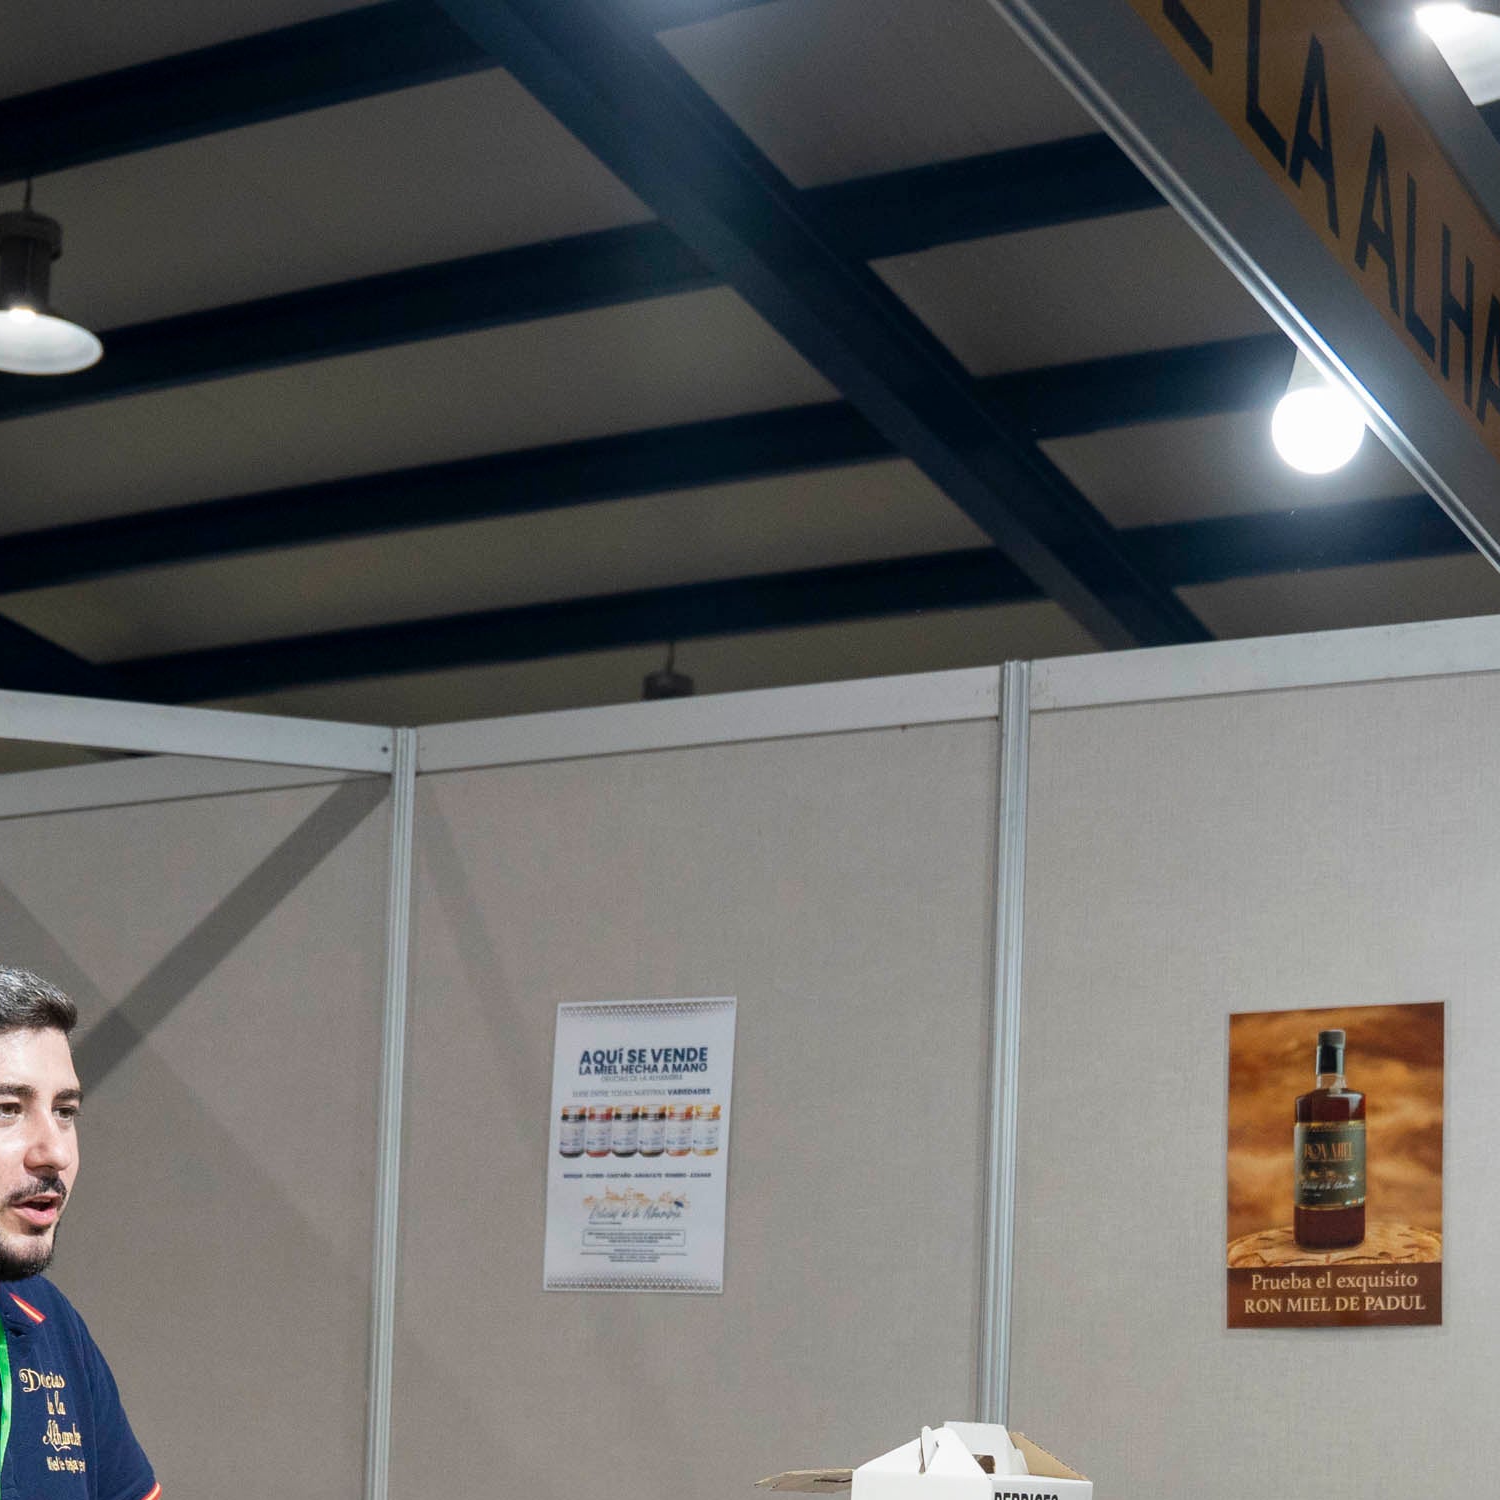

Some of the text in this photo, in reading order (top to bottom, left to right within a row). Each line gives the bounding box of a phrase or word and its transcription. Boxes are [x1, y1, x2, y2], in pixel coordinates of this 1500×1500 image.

[1246, 0, 1340, 239] LA
[627, 1049, 647, 1064] SE
[651, 1047, 708, 1063] VENDE
[579, 1063, 708, 1076] LA MIEL HECHA A MANO
[1251, 1270, 1419, 1295] Prueba el exquisito
[1244, 1294, 1426, 1314] RON MIEL DE PADUL
